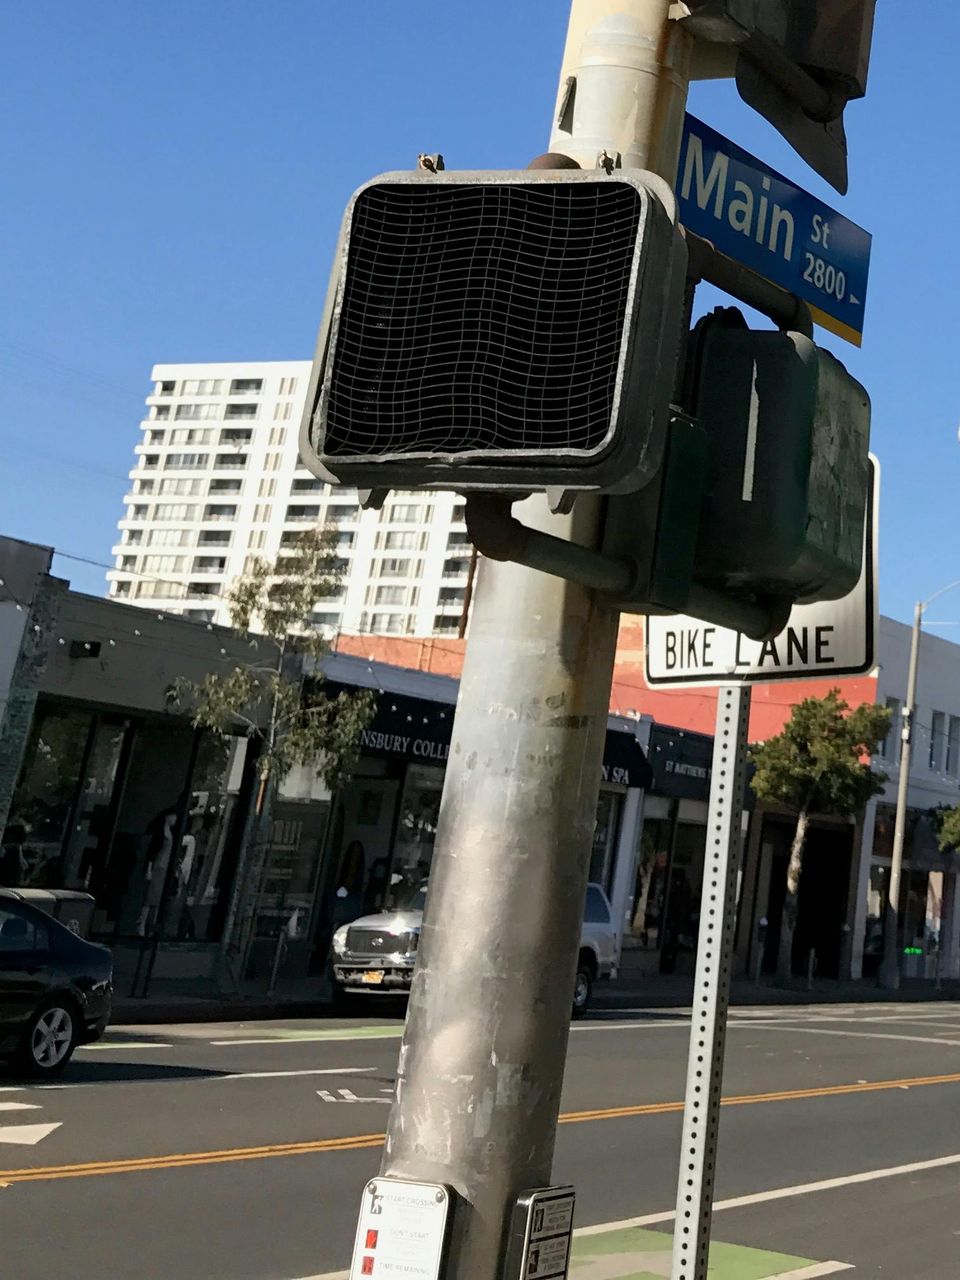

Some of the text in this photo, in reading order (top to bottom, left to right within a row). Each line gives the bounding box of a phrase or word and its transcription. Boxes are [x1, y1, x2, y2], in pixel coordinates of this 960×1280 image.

[681, 133, 831, 262] Main St
[803, 252, 846, 300] 2800
[666, 625, 835, 670] BIKE LANE
[360, 729, 411, 753] NSBURY
[611, 766, 630, 785] SPA
